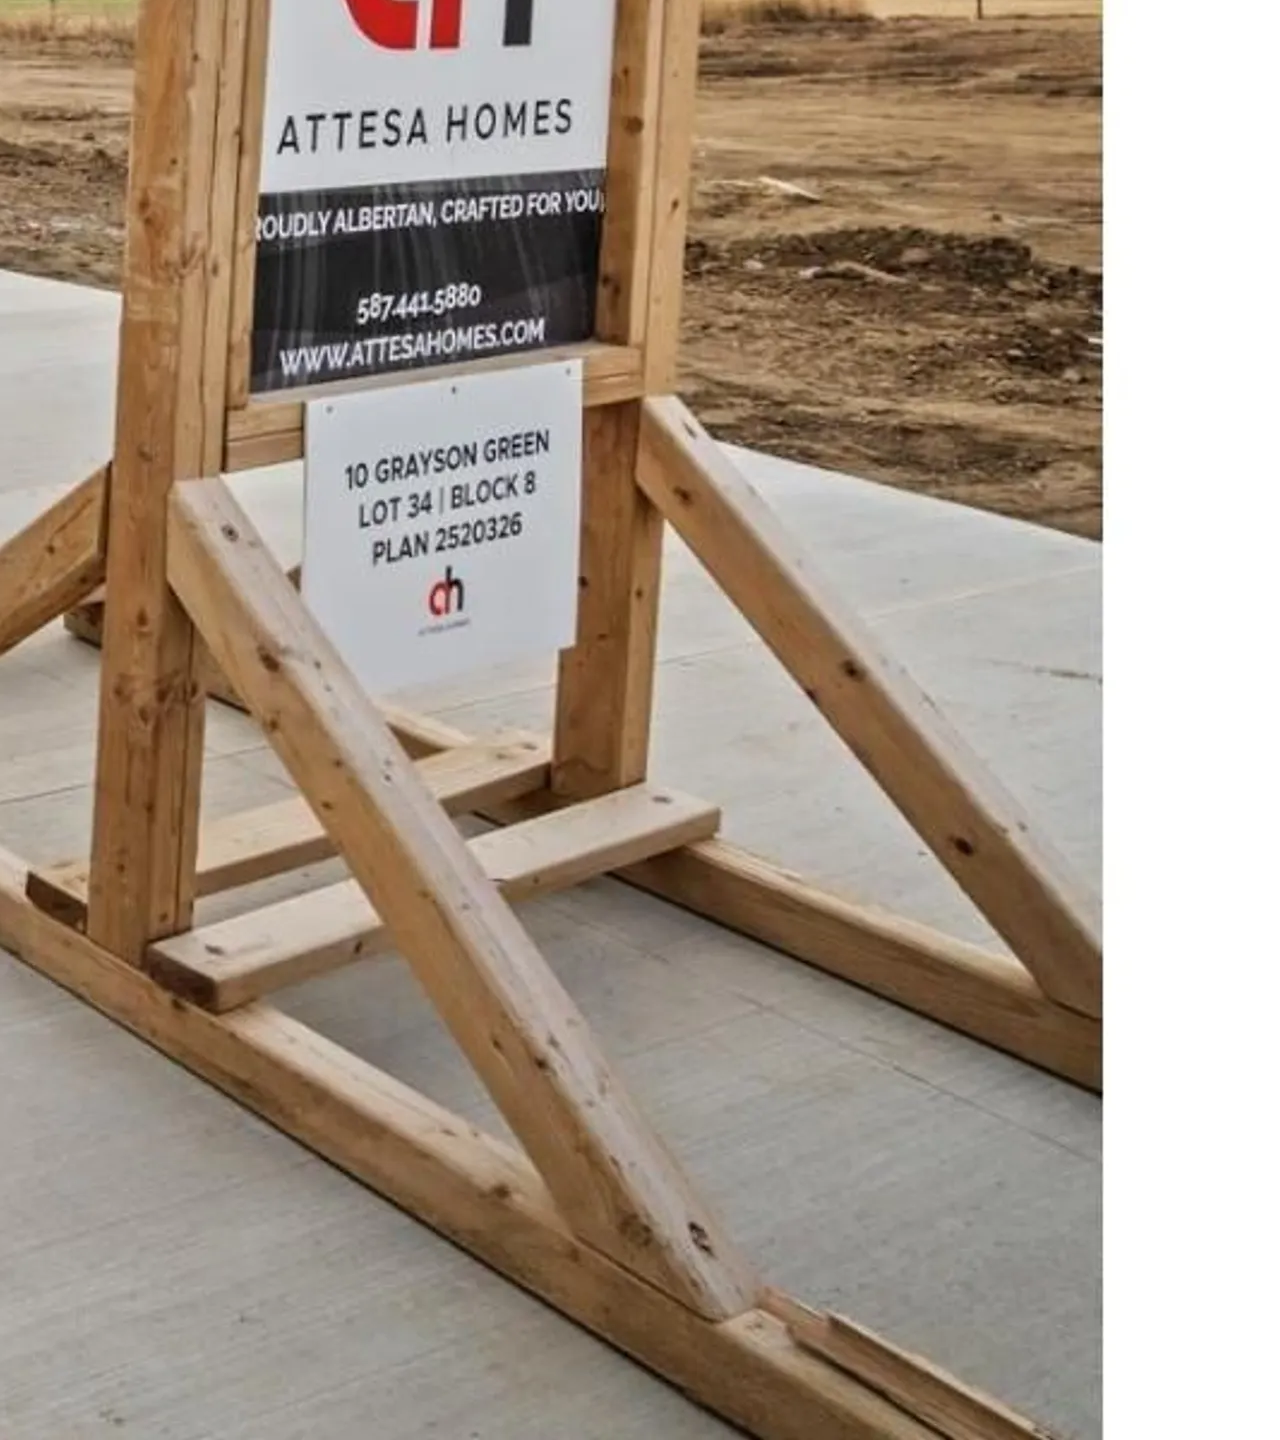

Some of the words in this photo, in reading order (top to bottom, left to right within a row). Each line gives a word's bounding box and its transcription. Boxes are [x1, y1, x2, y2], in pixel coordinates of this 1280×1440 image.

[276, 107, 428, 154] ATTESA
[445, 98, 572, 143] HOMES
[332, 201, 437, 234] ALBERTAN,
[441, 192, 524, 225] CRAFTED
[526, 190, 561, 216] FOR
[356, 281, 482, 325] 587.441.5880
[279, 317, 546, 376] WWW.ATTESAHOMES.COM
[345, 462, 369, 490] 10
[374, 441, 478, 484] GRAYSON
[483, 429, 550, 463] GREEN
[358, 497, 402, 529] LOT
[407, 490, 433, 519] 34
[451, 473, 518, 511] BLOCK
[524, 470, 536, 495] 8
[373, 530, 430, 566] PLAN
[435, 511, 523, 553] 2520326
